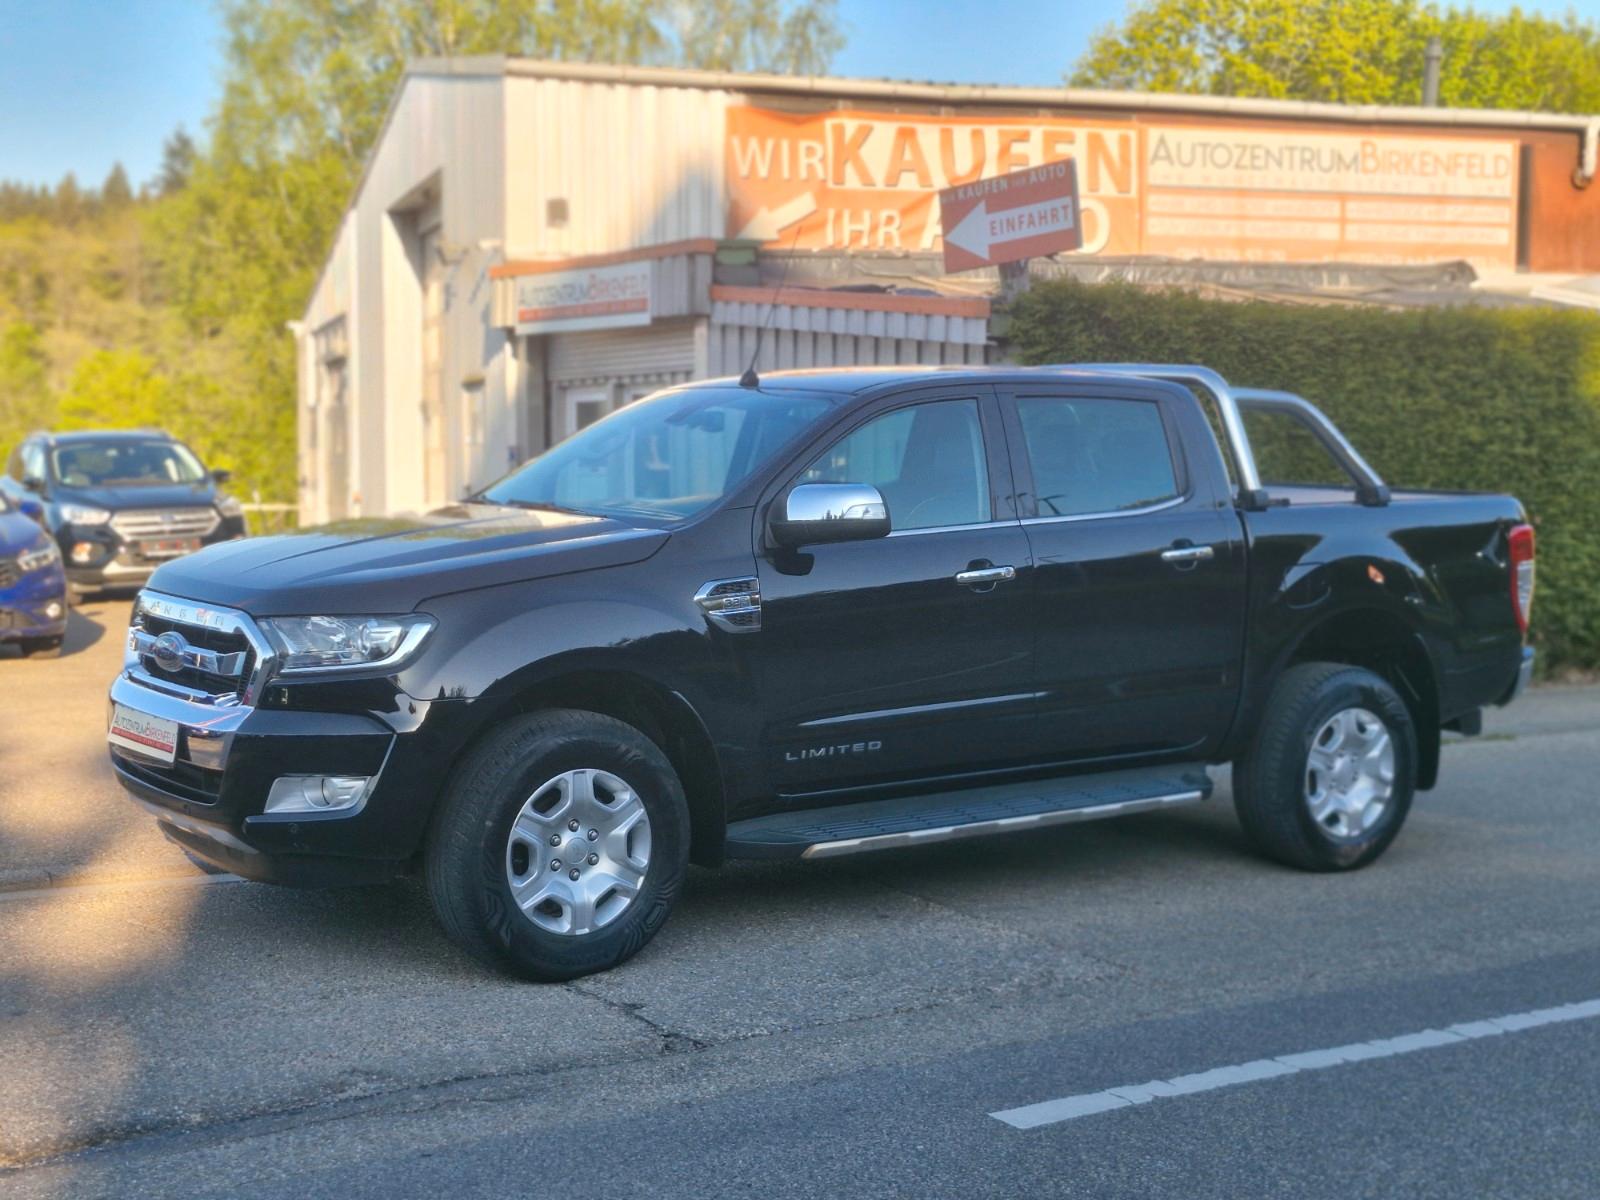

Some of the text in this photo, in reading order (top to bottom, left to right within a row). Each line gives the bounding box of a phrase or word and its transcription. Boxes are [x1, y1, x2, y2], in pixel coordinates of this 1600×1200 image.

[731, 136, 826, 181] WIR
[1149, 132, 1510, 180] AUTOZENTRUMBIRKENFELD
[957, 178, 1008, 201] KAUFEN
[1029, 163, 1066, 183] AUTO
[824, 207, 901, 248] IHR
[989, 204, 1071, 237] EINFAHRT
[785, 740, 882, 761] LIMITED
